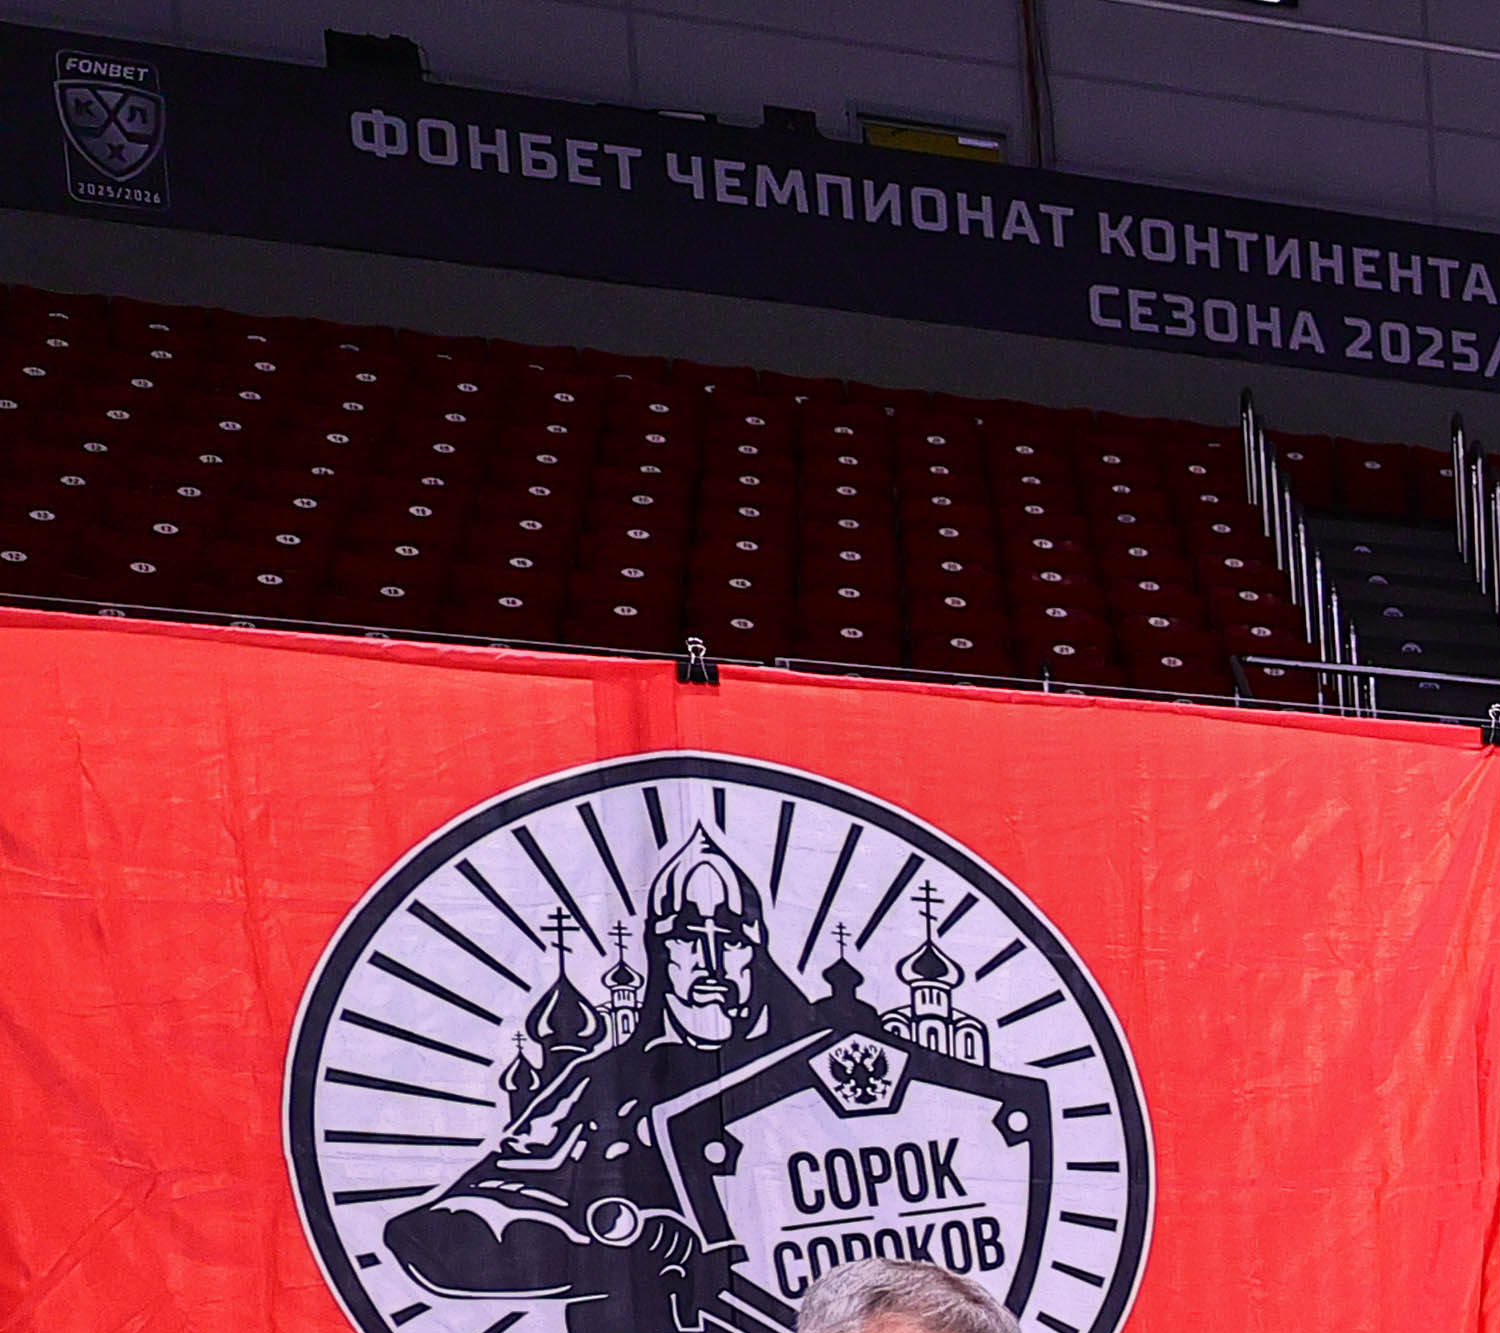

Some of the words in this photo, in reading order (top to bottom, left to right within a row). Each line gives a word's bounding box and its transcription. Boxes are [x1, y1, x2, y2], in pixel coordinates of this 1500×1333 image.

[65, 57, 149, 82] FONBET
[77, 182, 161, 204] 2025/2026
[350, 107, 643, 191] ФОНБЕТ
[666, 151, 1074, 249] ЧЕМПИОНАТ
[1088, 284, 1326, 356] СЕЗОНА
[788, 1138, 967, 1215] СОРОК
